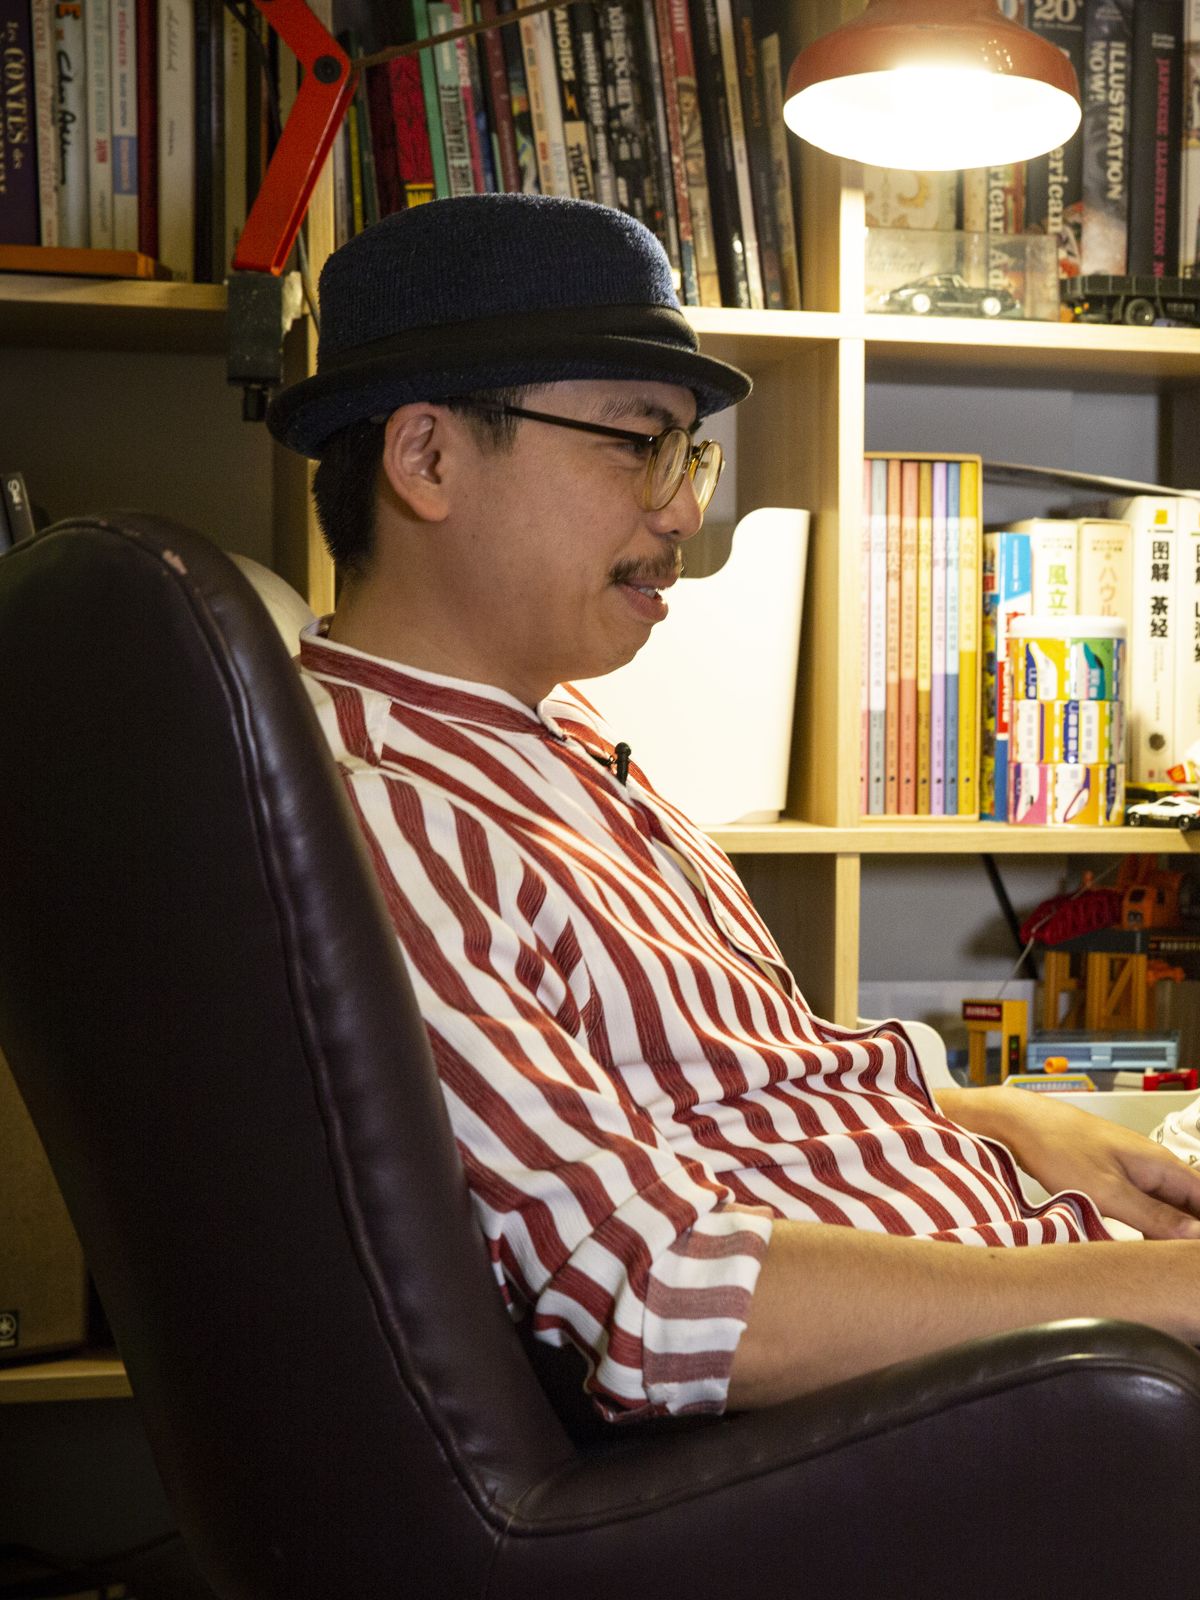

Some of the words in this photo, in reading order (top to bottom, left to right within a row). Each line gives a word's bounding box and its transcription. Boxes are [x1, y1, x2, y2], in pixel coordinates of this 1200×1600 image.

[553, 6, 577, 83] ANOIDS
[1088, 40, 1107, 102] NOW!
[5, 46, 28, 145] CONTES
[1106, 40, 1127, 200] ILLUSTRATION
[1155, 58, 1171, 135] JAPANESE
[988, 166, 1010, 241] rican
[1047, 150, 1069, 234] erican
[1153, 140, 1170, 255] ILLUSTRATION
[1047, 564, 1068, 615] 風立
[1150, 540, 1170, 582] 图解
[1149, 595, 1169, 638] 茶经
